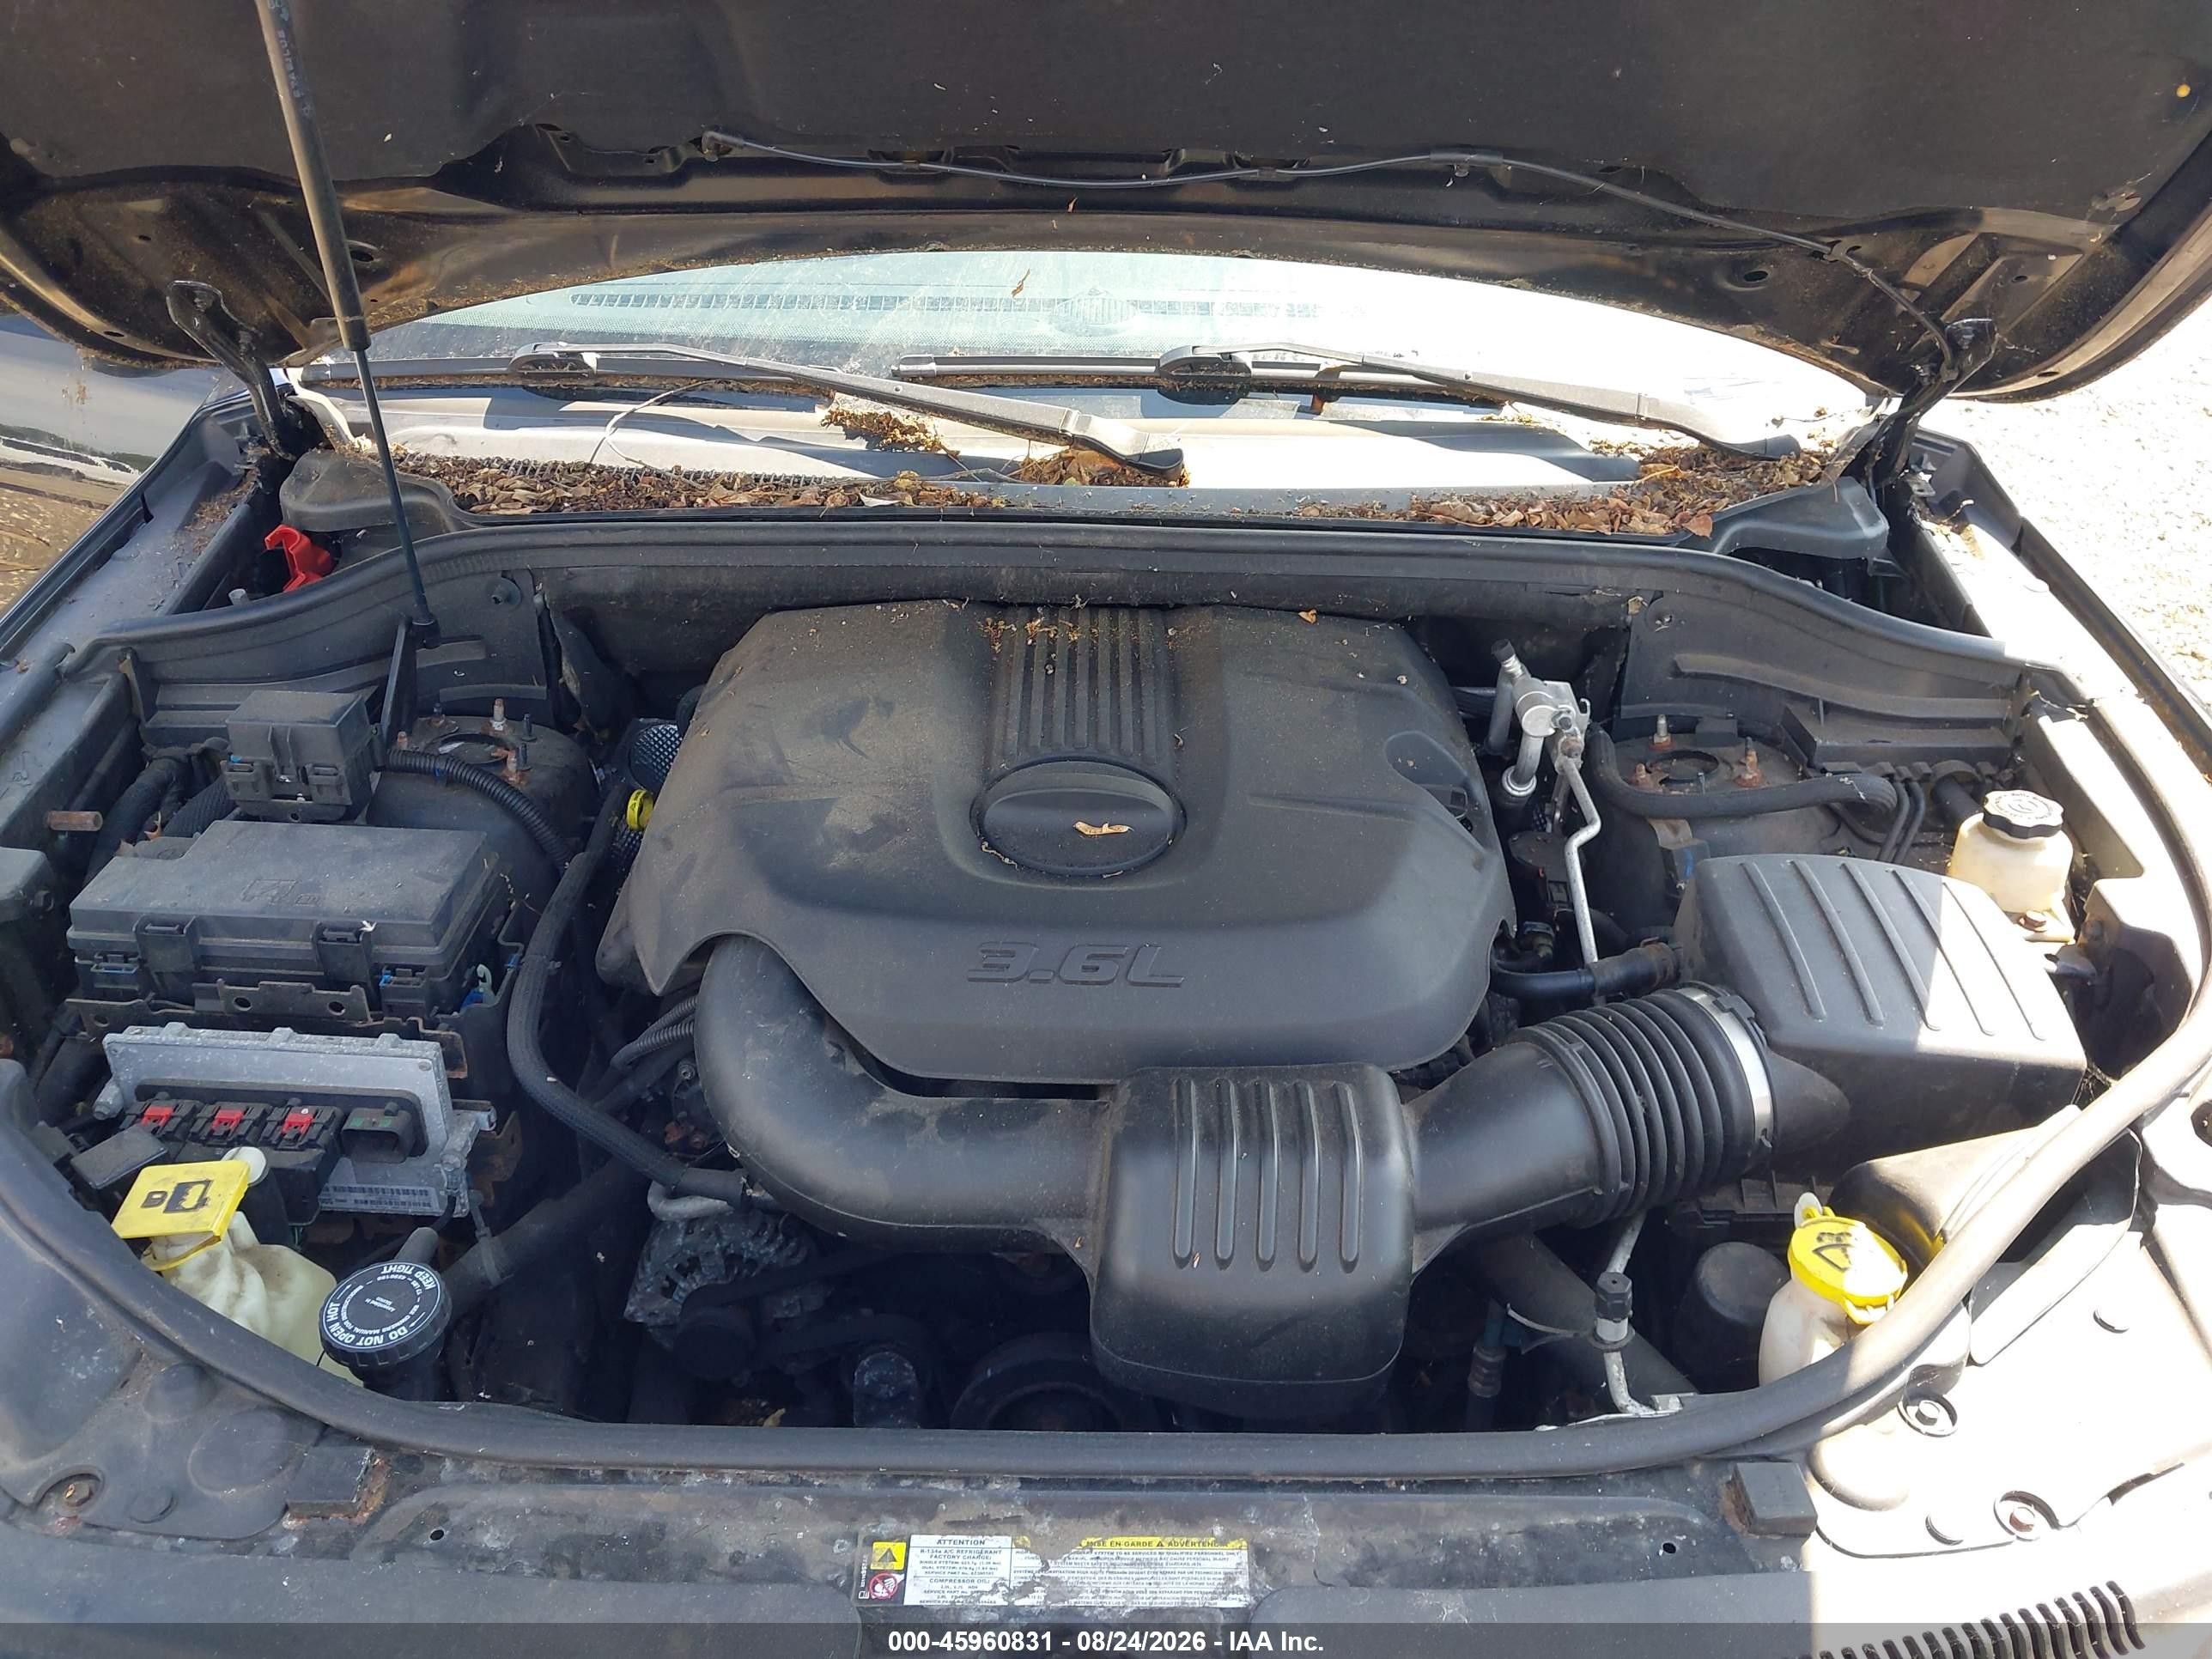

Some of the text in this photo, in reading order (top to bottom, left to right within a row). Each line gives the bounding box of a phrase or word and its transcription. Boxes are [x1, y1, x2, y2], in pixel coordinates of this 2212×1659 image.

[967, 941, 1185, 988] 3.6L
[380, 1264, 416, 1275] TIGHT
[414, 1271, 436, 1290] KEEP
[326, 1302, 409, 1346] DO NOT OPEN HOT
